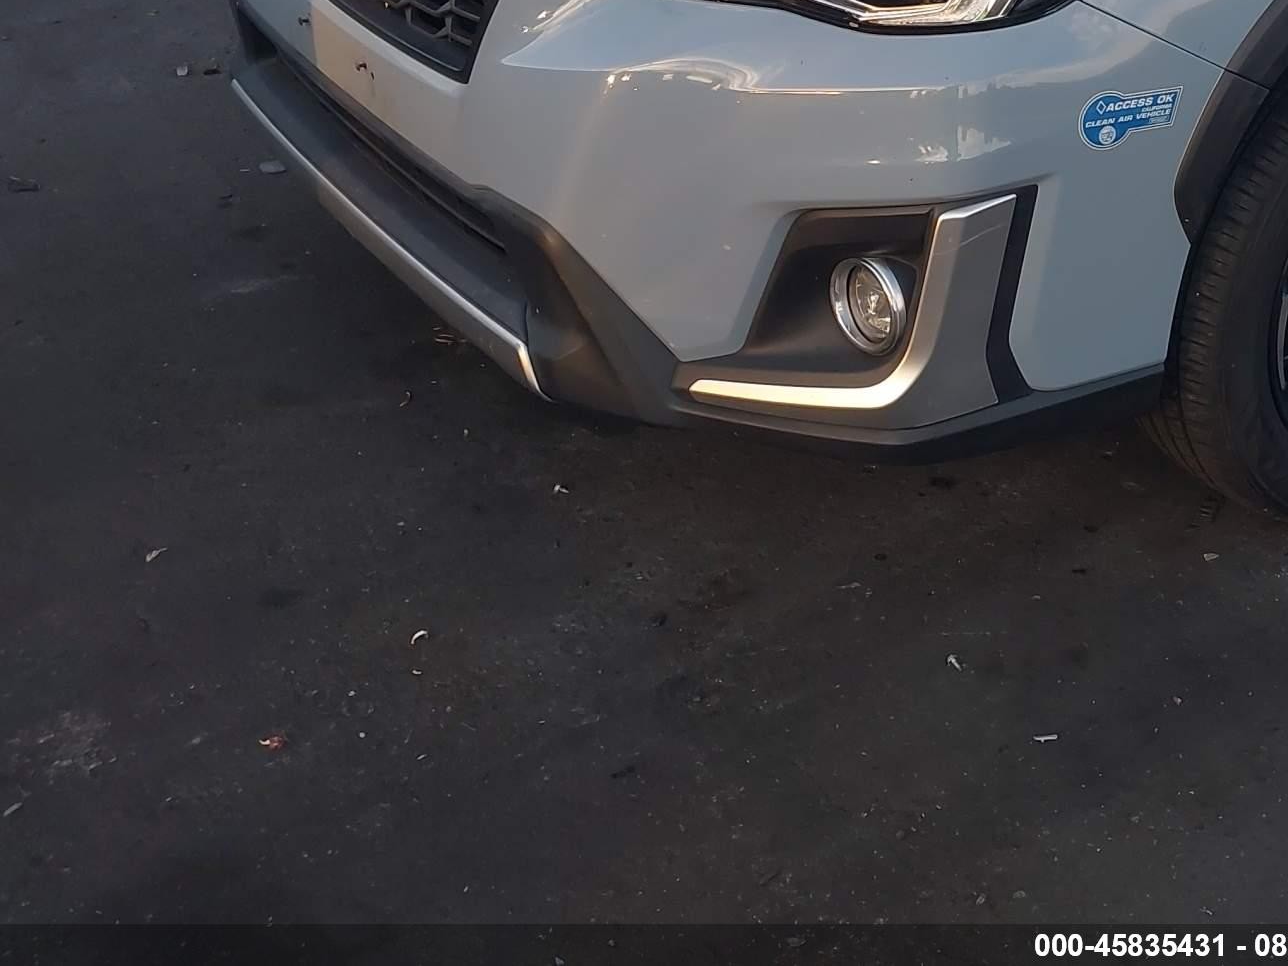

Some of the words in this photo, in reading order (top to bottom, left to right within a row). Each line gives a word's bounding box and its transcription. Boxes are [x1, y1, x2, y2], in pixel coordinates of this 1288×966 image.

[1106, 96, 1154, 113] ACCESS
[1157, 93, 1175, 104] OK
[1085, 117, 1115, 128] CLEAN
[1118, 114, 1133, 123] AIR
[1136, 108, 1172, 120] VEHICLE
